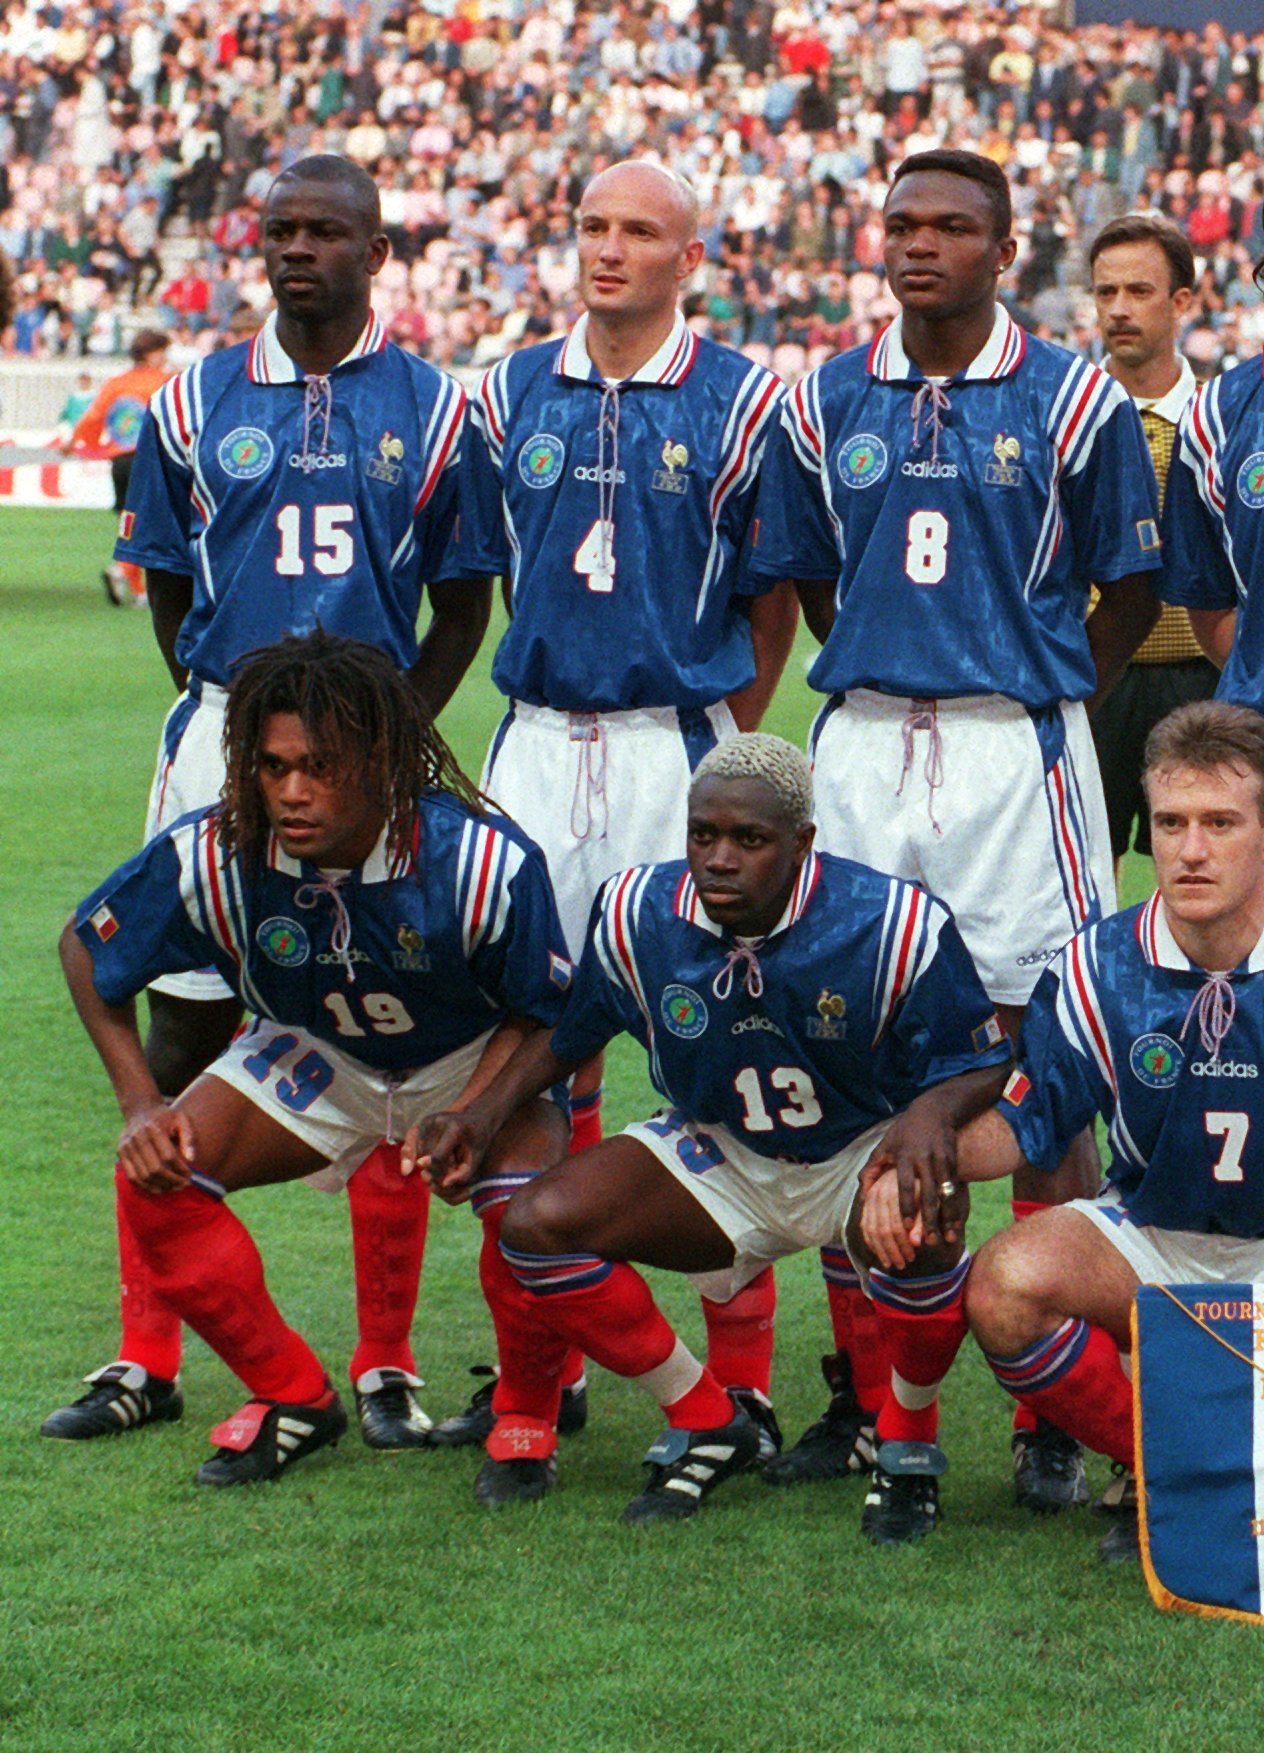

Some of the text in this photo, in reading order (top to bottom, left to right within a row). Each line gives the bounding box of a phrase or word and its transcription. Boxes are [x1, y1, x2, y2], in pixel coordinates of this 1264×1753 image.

[901, 461, 959, 479] adidas
[275, 503, 354, 576] 15
[573, 518, 617, 593] 4
[905, 509, 949, 584] 8
[323, 991, 416, 1037] 19
[242, 1032, 336, 1113] 19
[734, 1066, 824, 1132] 13
[1190, 1059, 1259, 1079] adidas
[1204, 1111, 1250, 1182] 7
